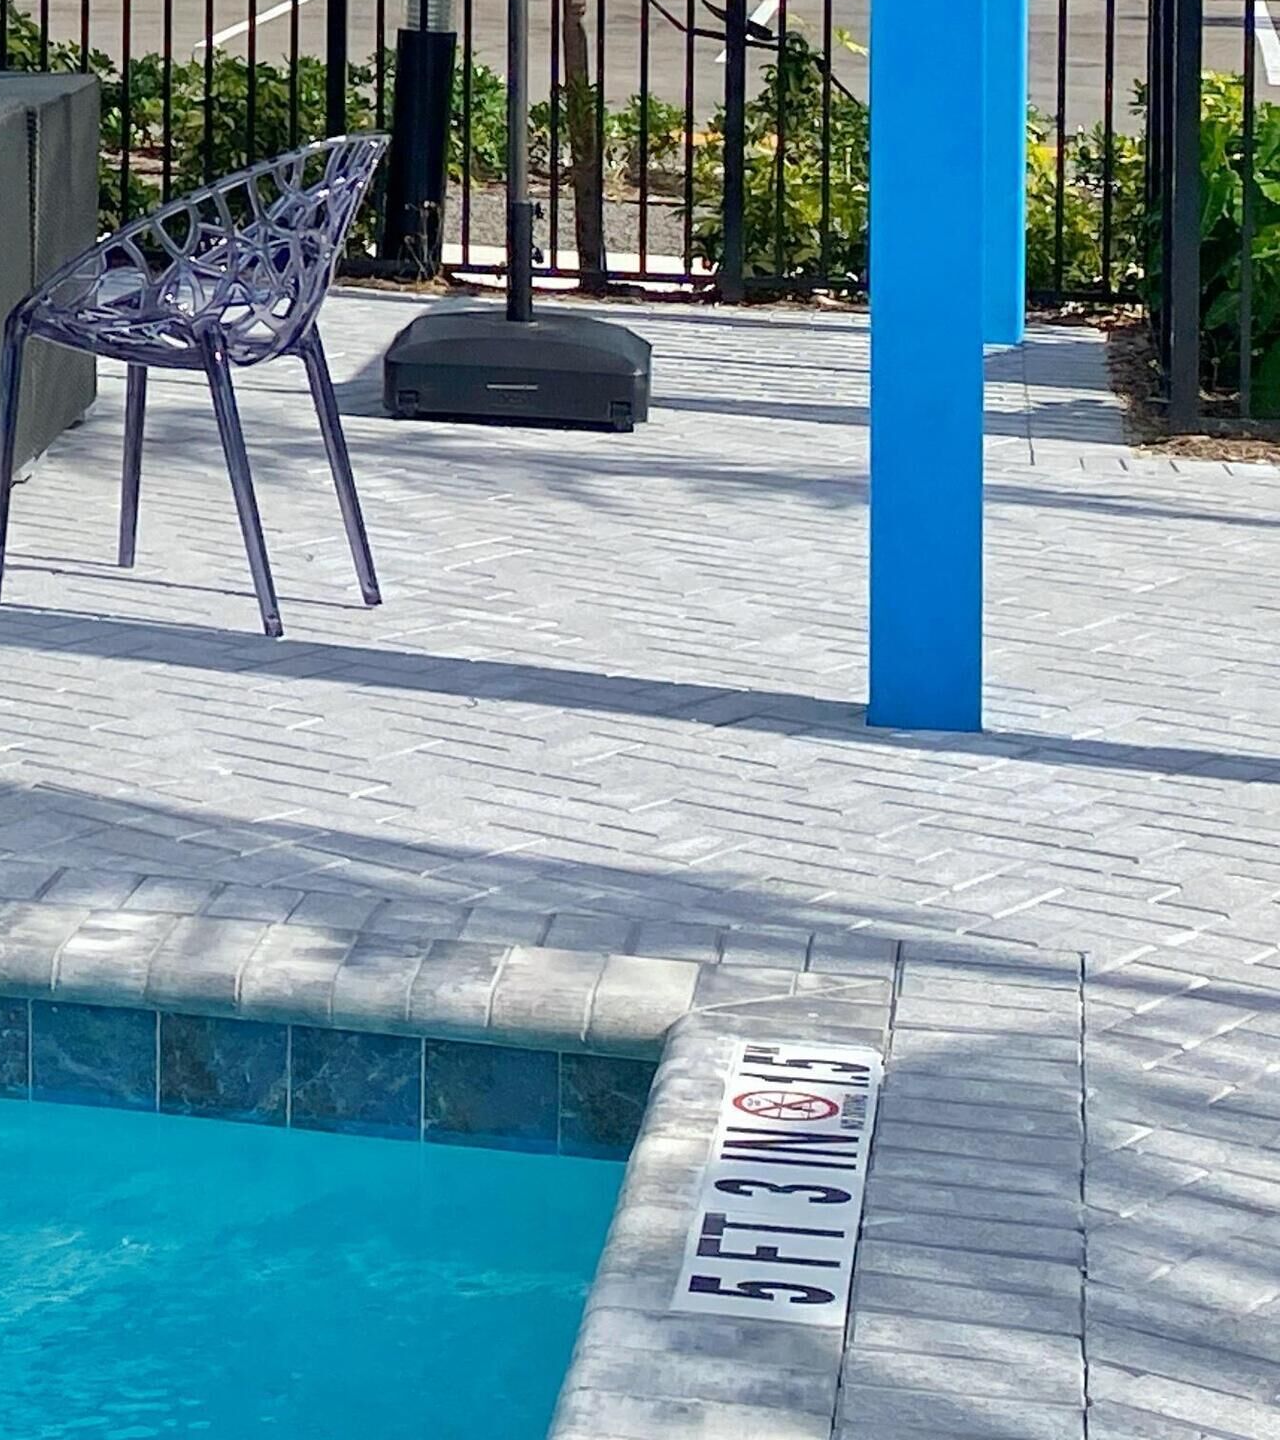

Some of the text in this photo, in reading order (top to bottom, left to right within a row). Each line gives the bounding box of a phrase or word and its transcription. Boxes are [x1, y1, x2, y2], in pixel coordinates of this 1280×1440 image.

[688, 1126, 859, 1304] 5 FT 3 IN
